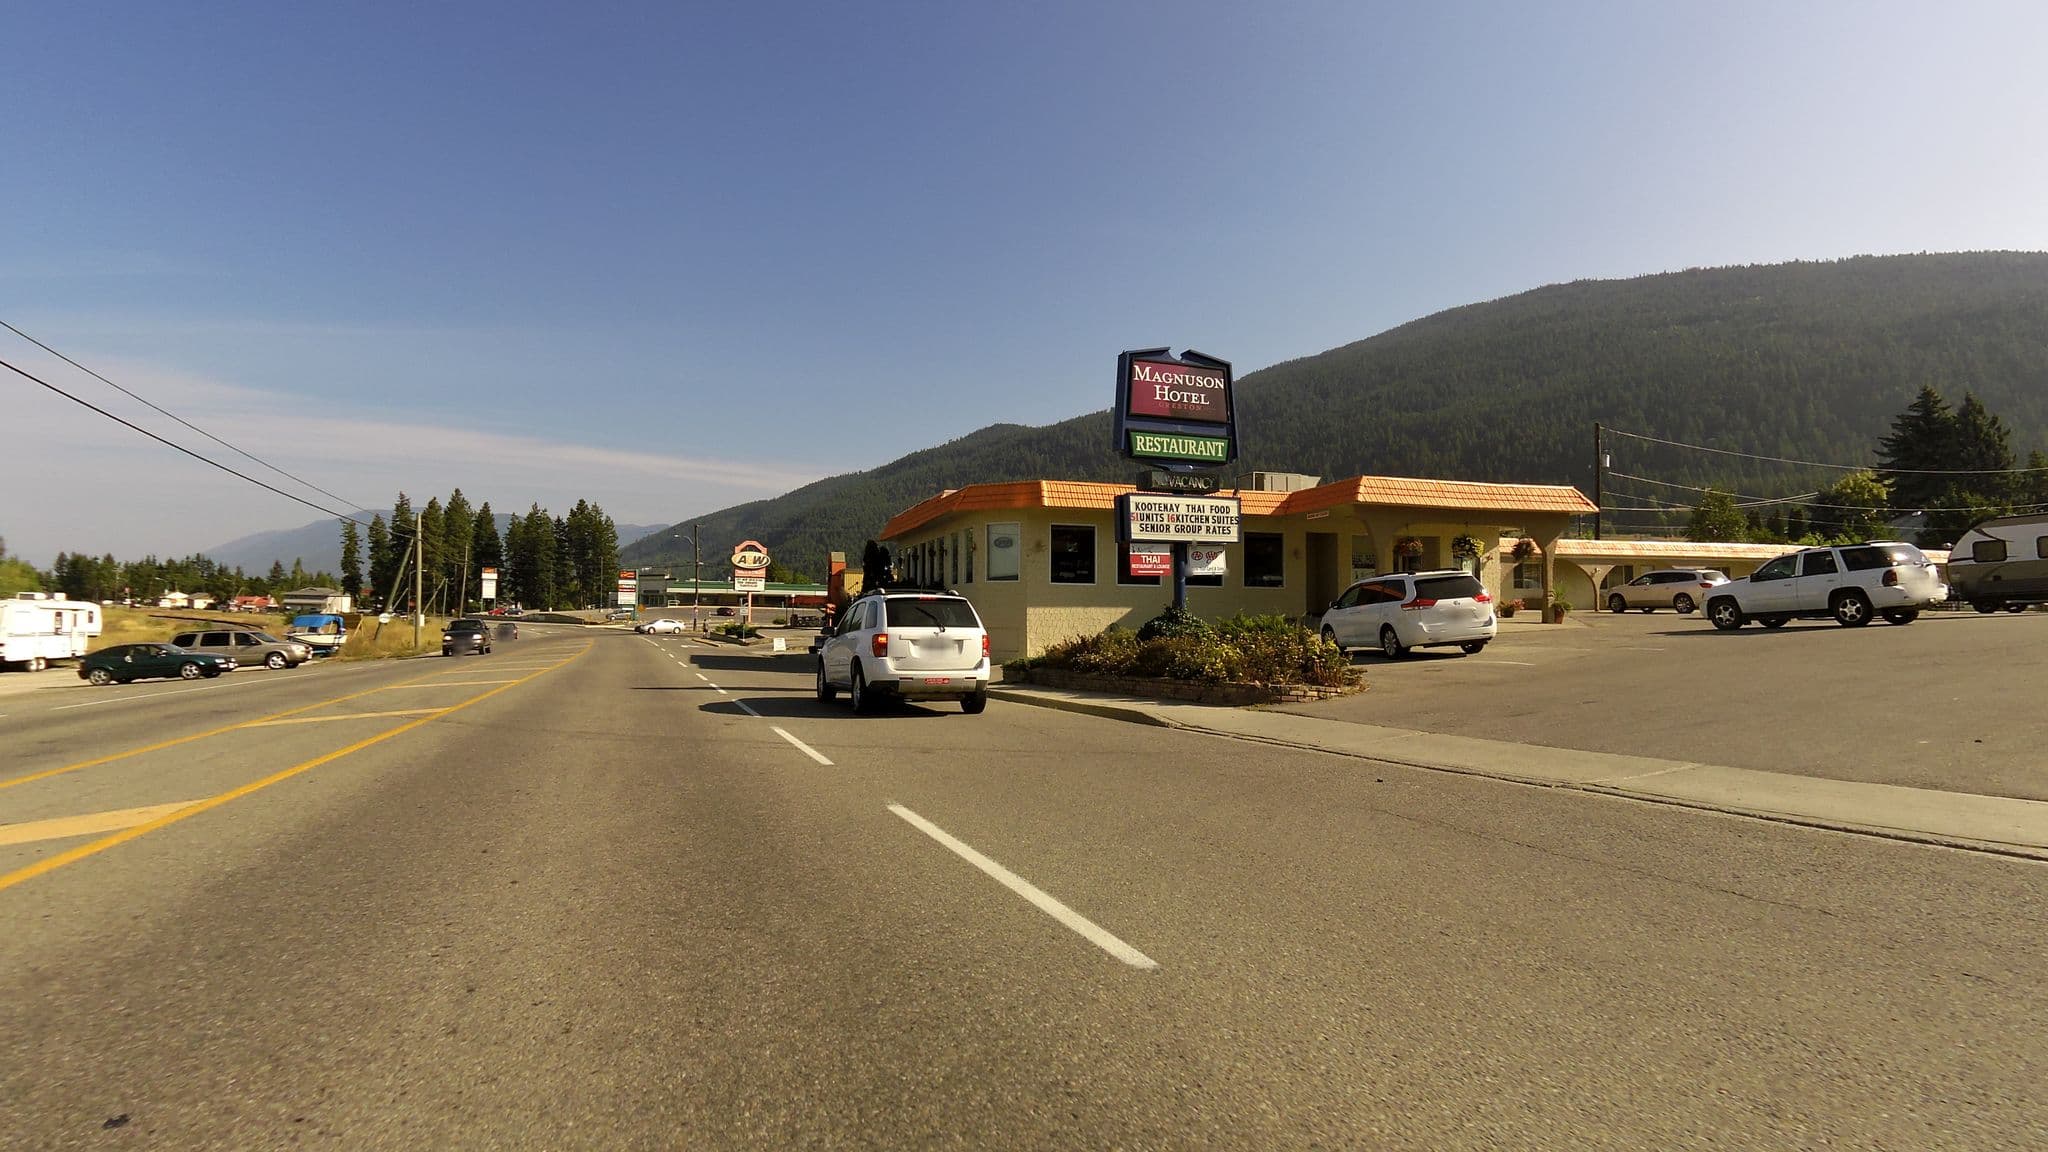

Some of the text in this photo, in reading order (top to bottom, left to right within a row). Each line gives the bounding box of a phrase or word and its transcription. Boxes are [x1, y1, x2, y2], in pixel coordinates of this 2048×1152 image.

[1133, 365, 1225, 389] MAGNUSON
[1154, 385, 1210, 405] HOTEL
[1136, 435, 1225, 457] RESTAURANT
[1135, 502, 1231, 515] KOOTENAY THAI FOOD
[1211, 515, 1240, 525] SUITES
[1139, 523, 1232, 535] SENIOR GROUP RATES
[1141, 555, 1161, 564] THAI
